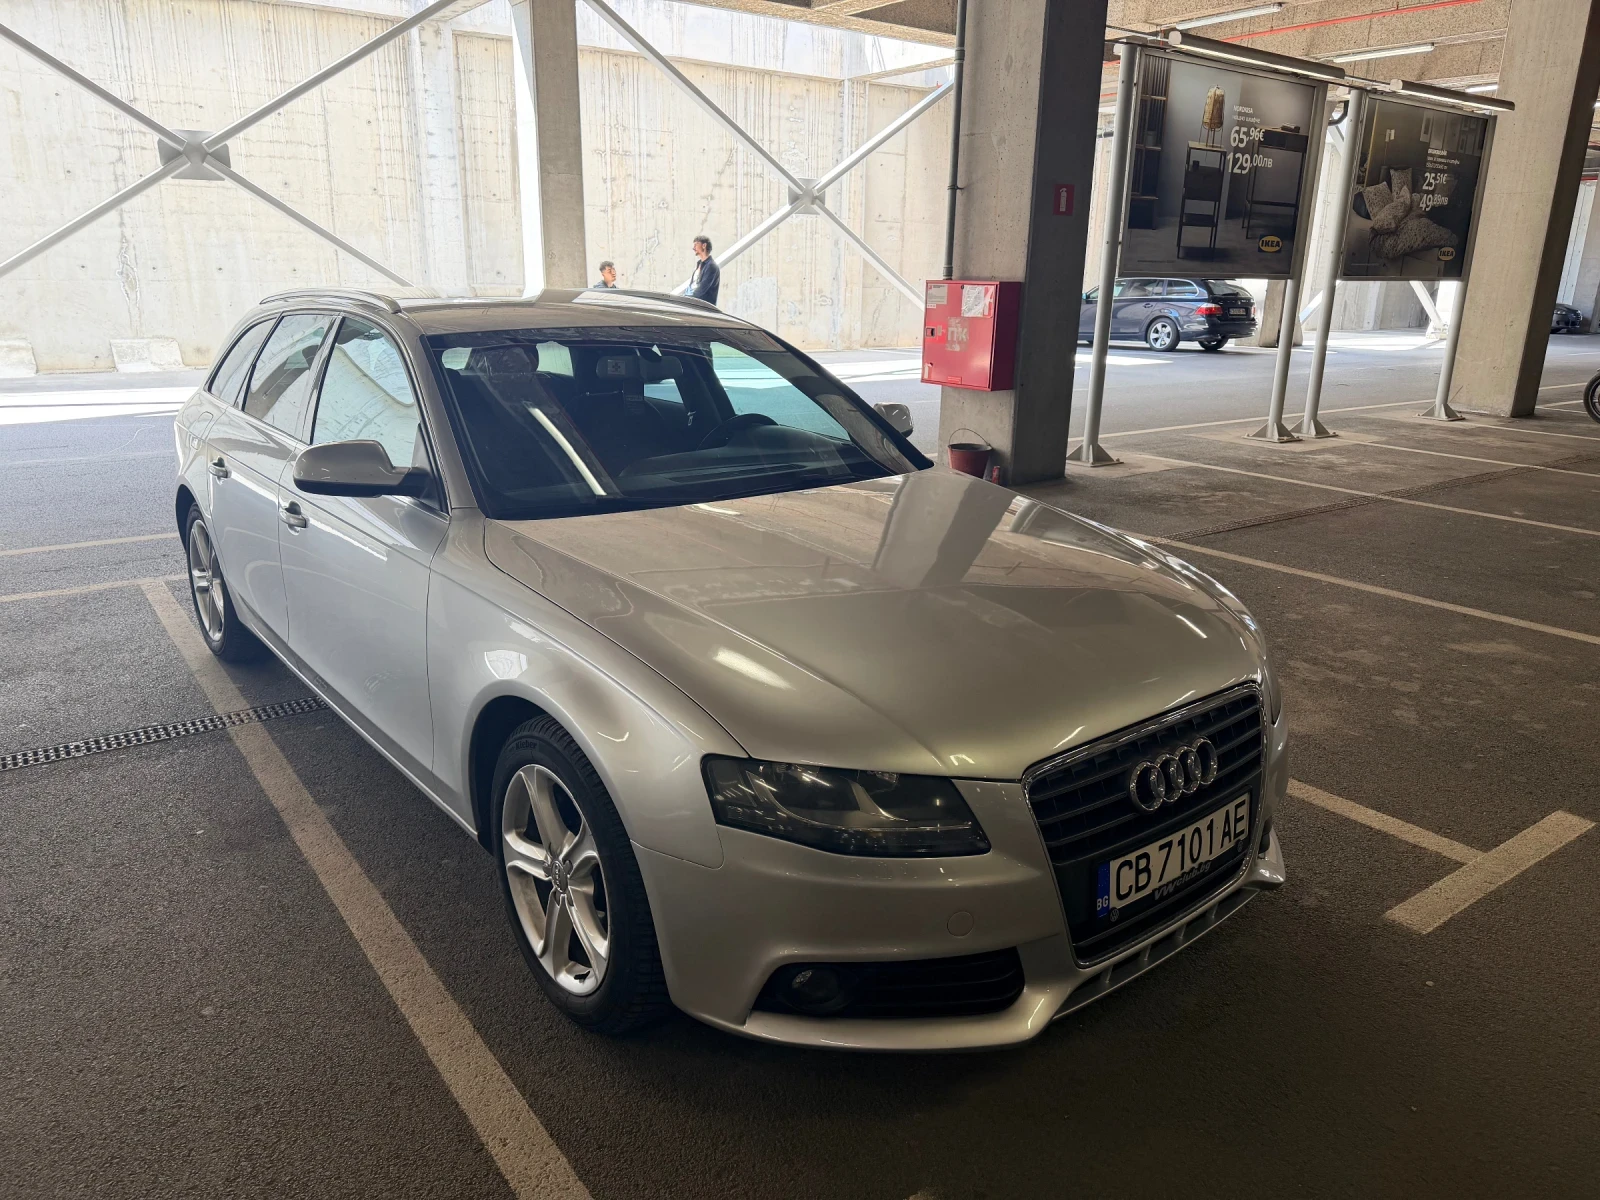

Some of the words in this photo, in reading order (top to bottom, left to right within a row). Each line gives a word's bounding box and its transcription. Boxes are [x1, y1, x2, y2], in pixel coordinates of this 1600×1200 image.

[1260, 239, 1281, 248] IKEA
[1157, 818, 1215, 883] 7101
[1096, 895, 1109, 911] BG
